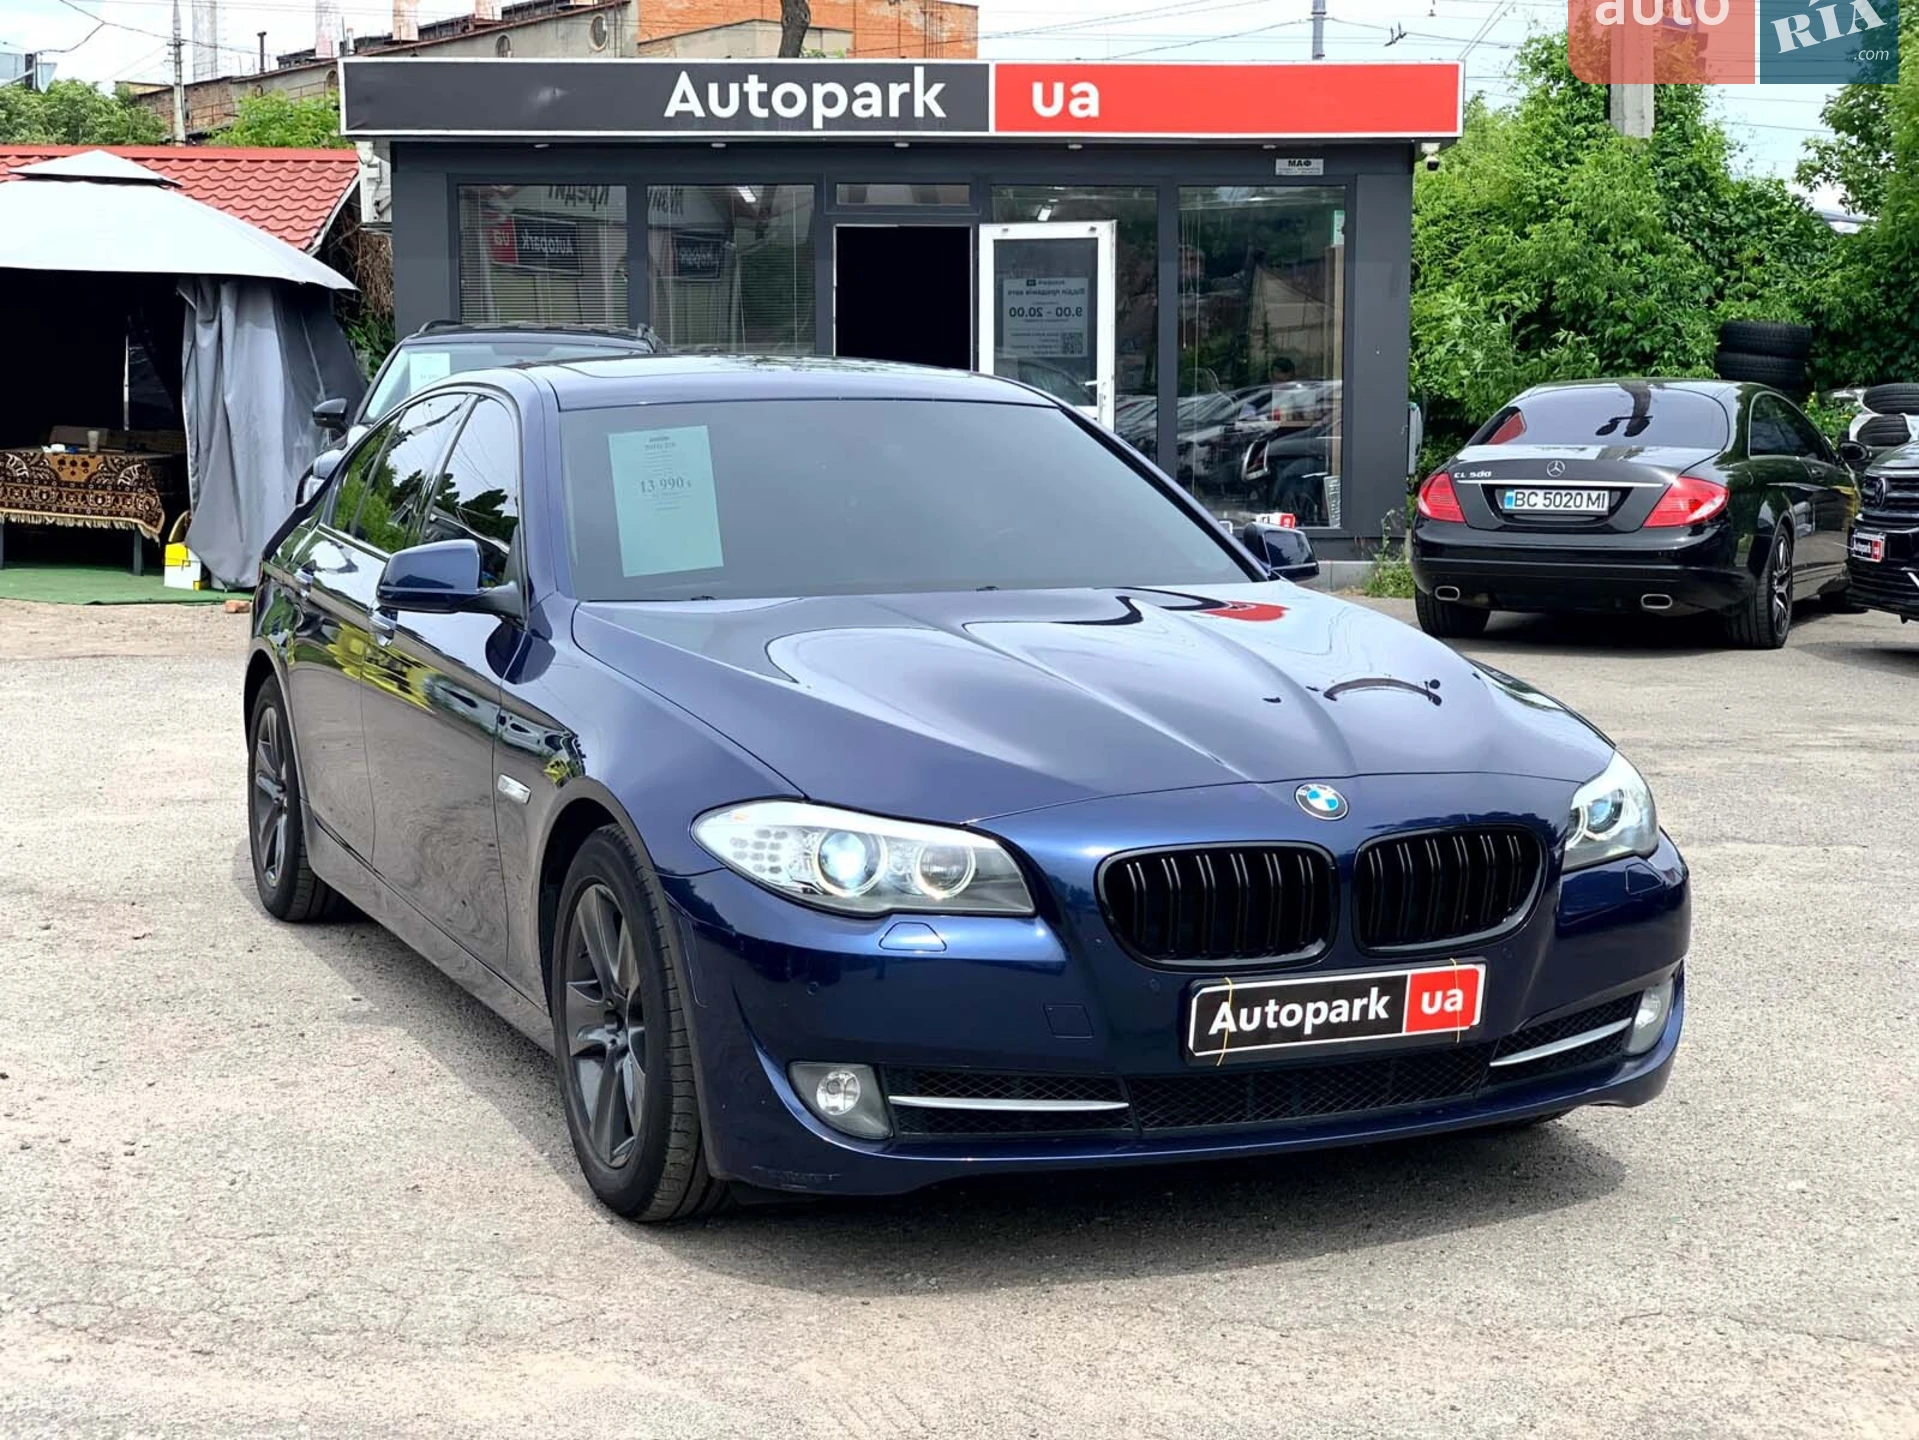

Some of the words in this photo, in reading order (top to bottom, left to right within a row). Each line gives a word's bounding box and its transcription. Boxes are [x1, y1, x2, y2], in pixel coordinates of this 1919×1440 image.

[663, 66, 947, 129] Autopark
[1031, 80, 1100, 118] ua
[640, 480, 656, 493] 13
[659, 476, 684, 490] 990
[1514, 491, 1539, 508] BC
[1543, 491, 1584, 509] 5020
[1586, 492, 1606, 509] MI
[1208, 986, 1391, 1035] Autopark
[1420, 987, 1464, 1015] ua
